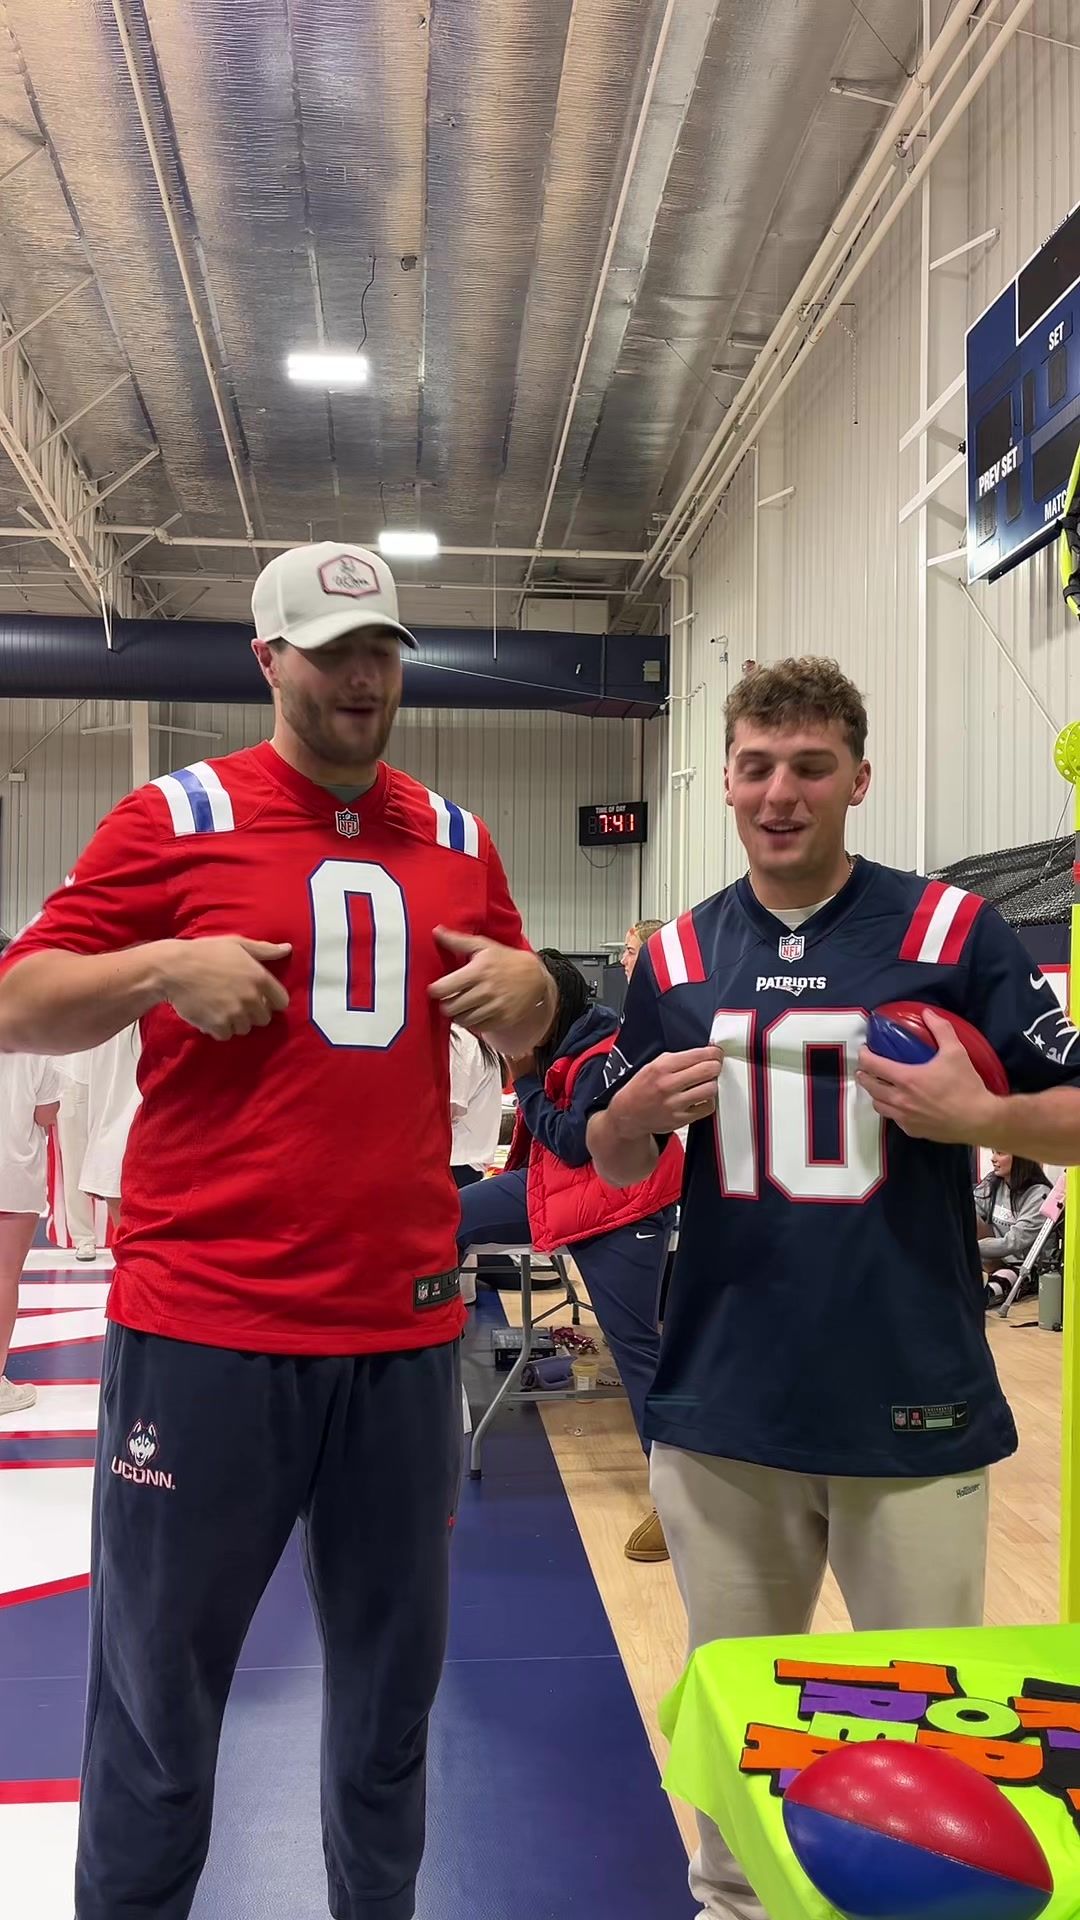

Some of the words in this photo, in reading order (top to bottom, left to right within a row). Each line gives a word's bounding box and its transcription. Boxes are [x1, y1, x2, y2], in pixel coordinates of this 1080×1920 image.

[1048, 321, 1064, 350] SET
[979, 461, 1000, 497] PREV
[1001, 446, 1018, 478] SET
[1044, 489, 1068, 522] MATC
[599, 814, 634, 832] 7:41
[308, 857, 409, 1051] 0
[782, 945, 801, 958] NFL
[756, 976, 827, 992] PATRIOTS
[709, 1008, 888, 1204] 10
[111, 1456, 172, 1489] UCONN
